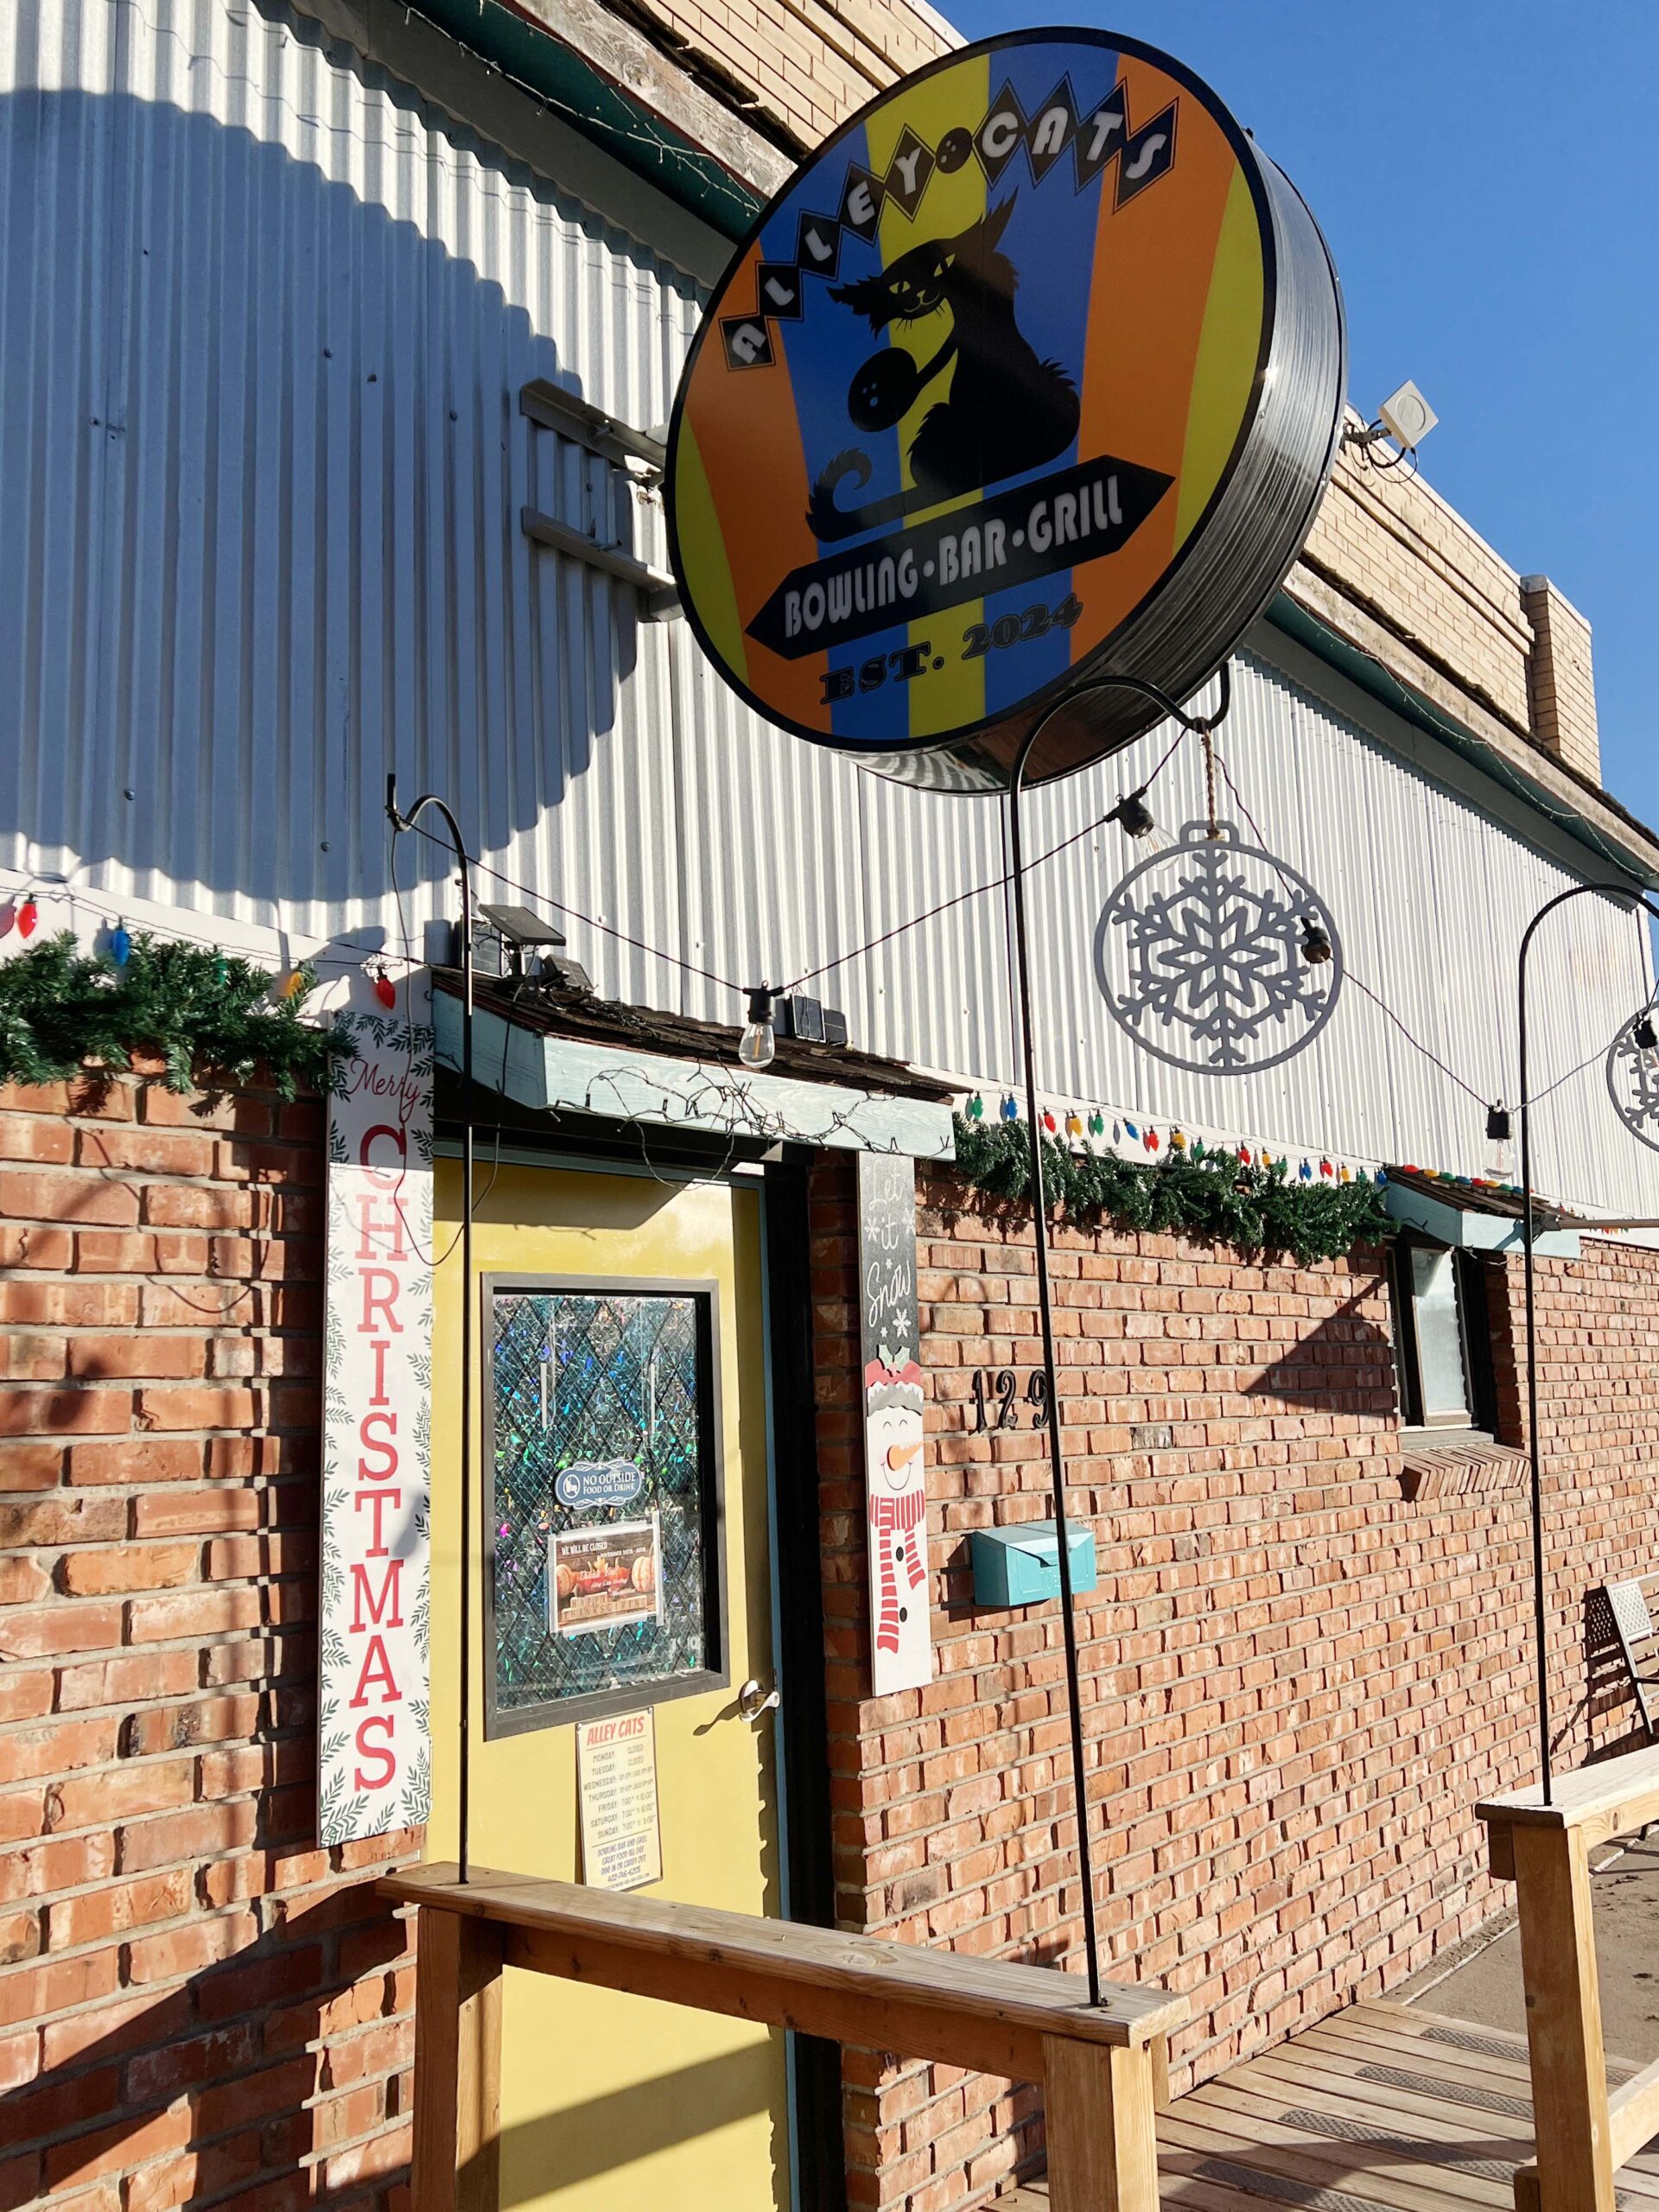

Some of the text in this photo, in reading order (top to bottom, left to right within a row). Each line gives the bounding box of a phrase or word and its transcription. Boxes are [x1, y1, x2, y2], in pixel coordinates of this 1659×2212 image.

[731, 106, 1167, 364] ALLEY CATS
[784, 474, 1123, 639] BOWLING BAR GRILL
[819, 593, 1084, 705] EST. 2024
[346, 1058, 421, 1122] Merry
[868, 1158, 903, 1211] Let
[880, 1211, 899, 1250] it
[867, 1259, 911, 1327] Snow
[973, 1370, 1048, 1433] 129
[348, 1124, 410, 1794] CHRISTMAS
[582, 1471, 636, 1486] NO OUTSIDE
[582, 1486, 601, 1495] FOOD
[613, 1483, 636, 1492] DRINK
[562, 1541, 607, 1555] WE WILL BE CLOSED
[564, 1599, 646, 1619] THANKSGIVING
[572, 1595, 606, 1607] HAPPY
[587, 1716, 645, 1745] ALLEY CATS
[627, 1744, 644, 1754] CLOSED
[627, 1756, 645, 1766] CLOSED
[598, 1844, 618, 1857] BOWLING
[618, 1841, 626, 1850] BAR
[626, 1838, 636, 1847] AND
